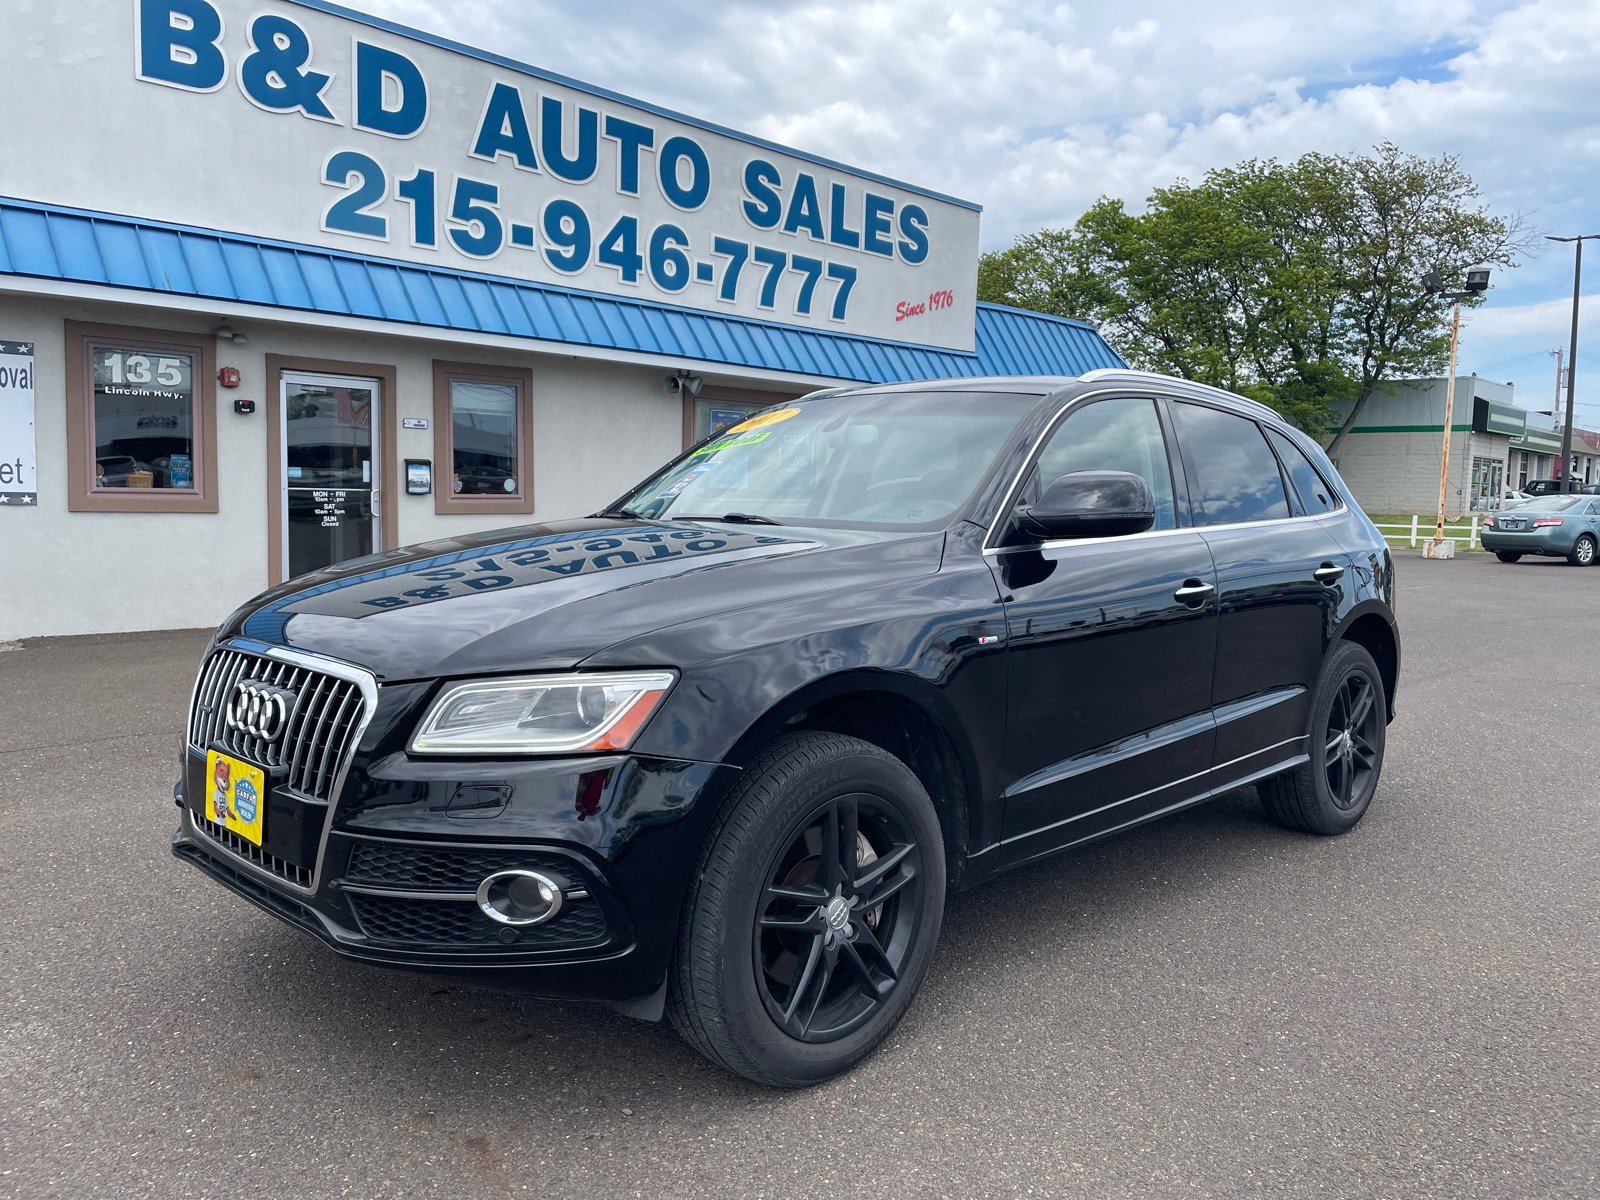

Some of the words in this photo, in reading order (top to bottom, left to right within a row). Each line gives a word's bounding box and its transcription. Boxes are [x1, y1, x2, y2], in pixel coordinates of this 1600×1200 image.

[136, 0, 429, 138] B&D
[469, 79, 710, 211] AUTO
[740, 157, 929, 265] SALES
[321, 149, 857, 322] 215-946-7777
[895, 301, 925, 321] Since
[929, 289, 953, 311] 1976
[105, 353, 182, 386] 135
[105, 386, 149, 396] Lincoln
[154, 390, 183, 399] Hwy.
